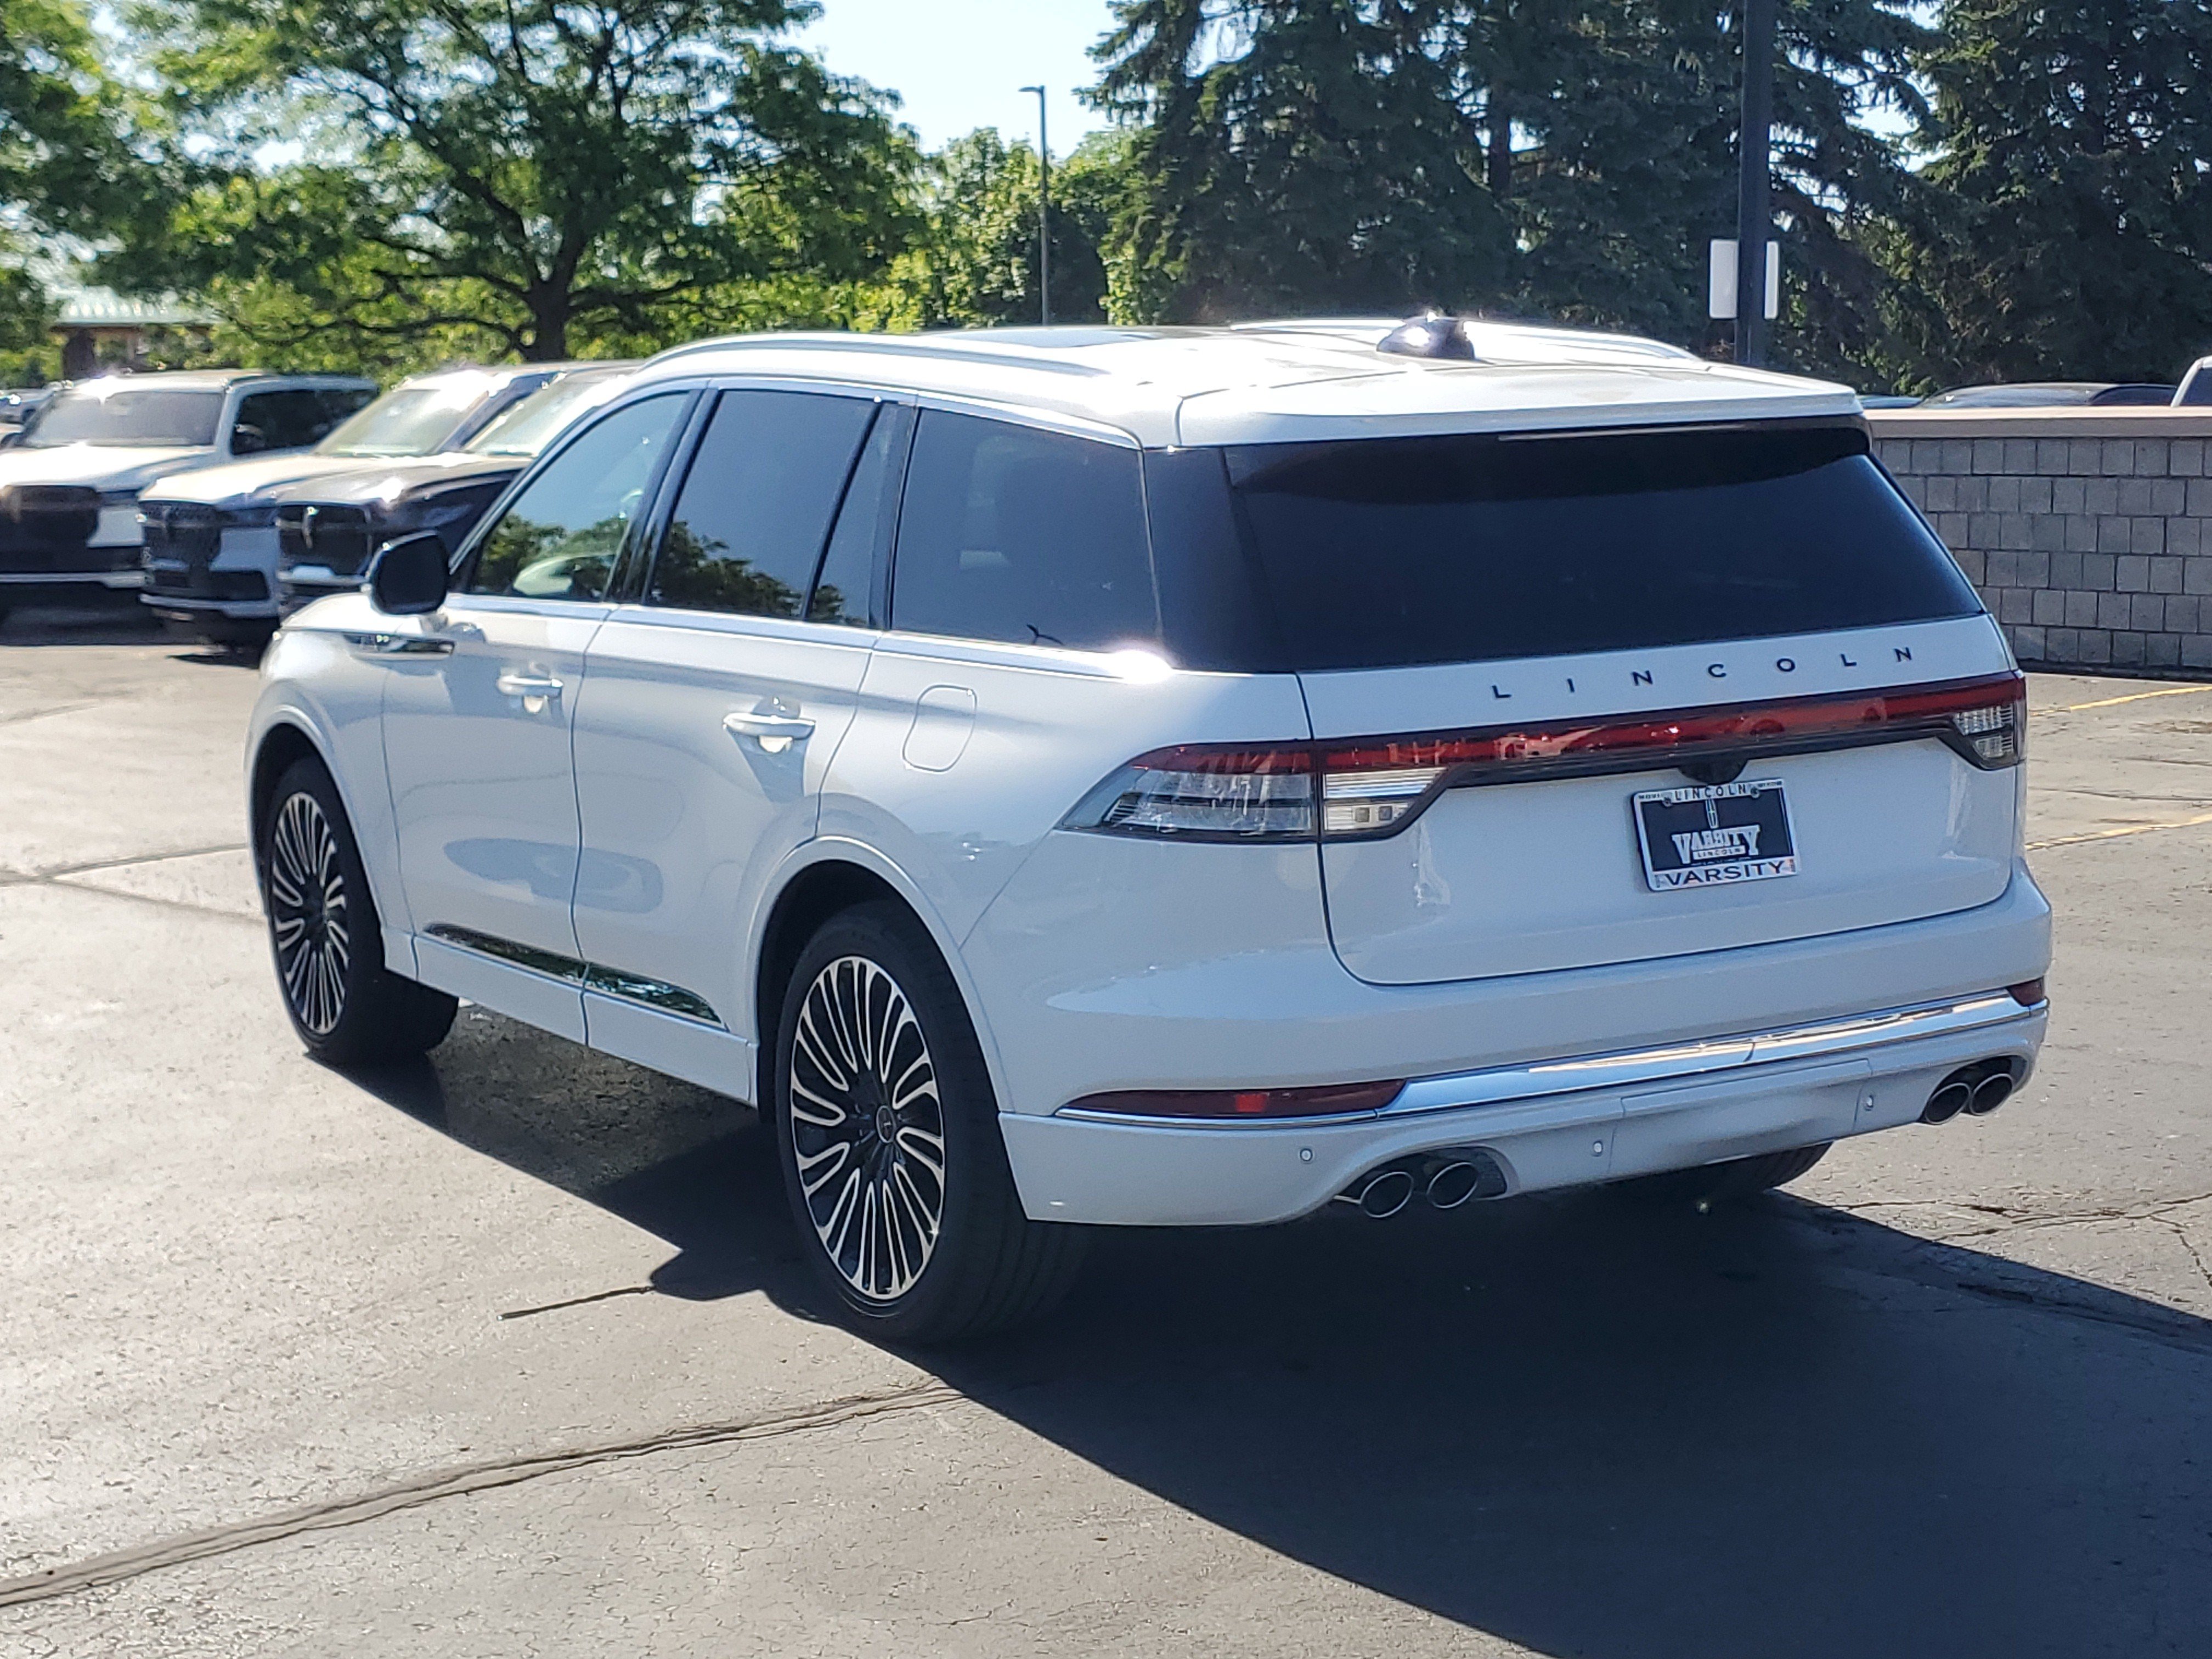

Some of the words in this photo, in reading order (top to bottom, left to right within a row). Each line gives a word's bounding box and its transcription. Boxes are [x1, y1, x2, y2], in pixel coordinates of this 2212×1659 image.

[1491, 646, 1912, 699] LINCOLN
[1675, 784, 1746, 800] LINCOLN
[1672, 825, 1760, 864] VARSITY
[1697, 848, 1741, 857] LINCOLN
[1666, 861, 1785, 885] VARSITY
